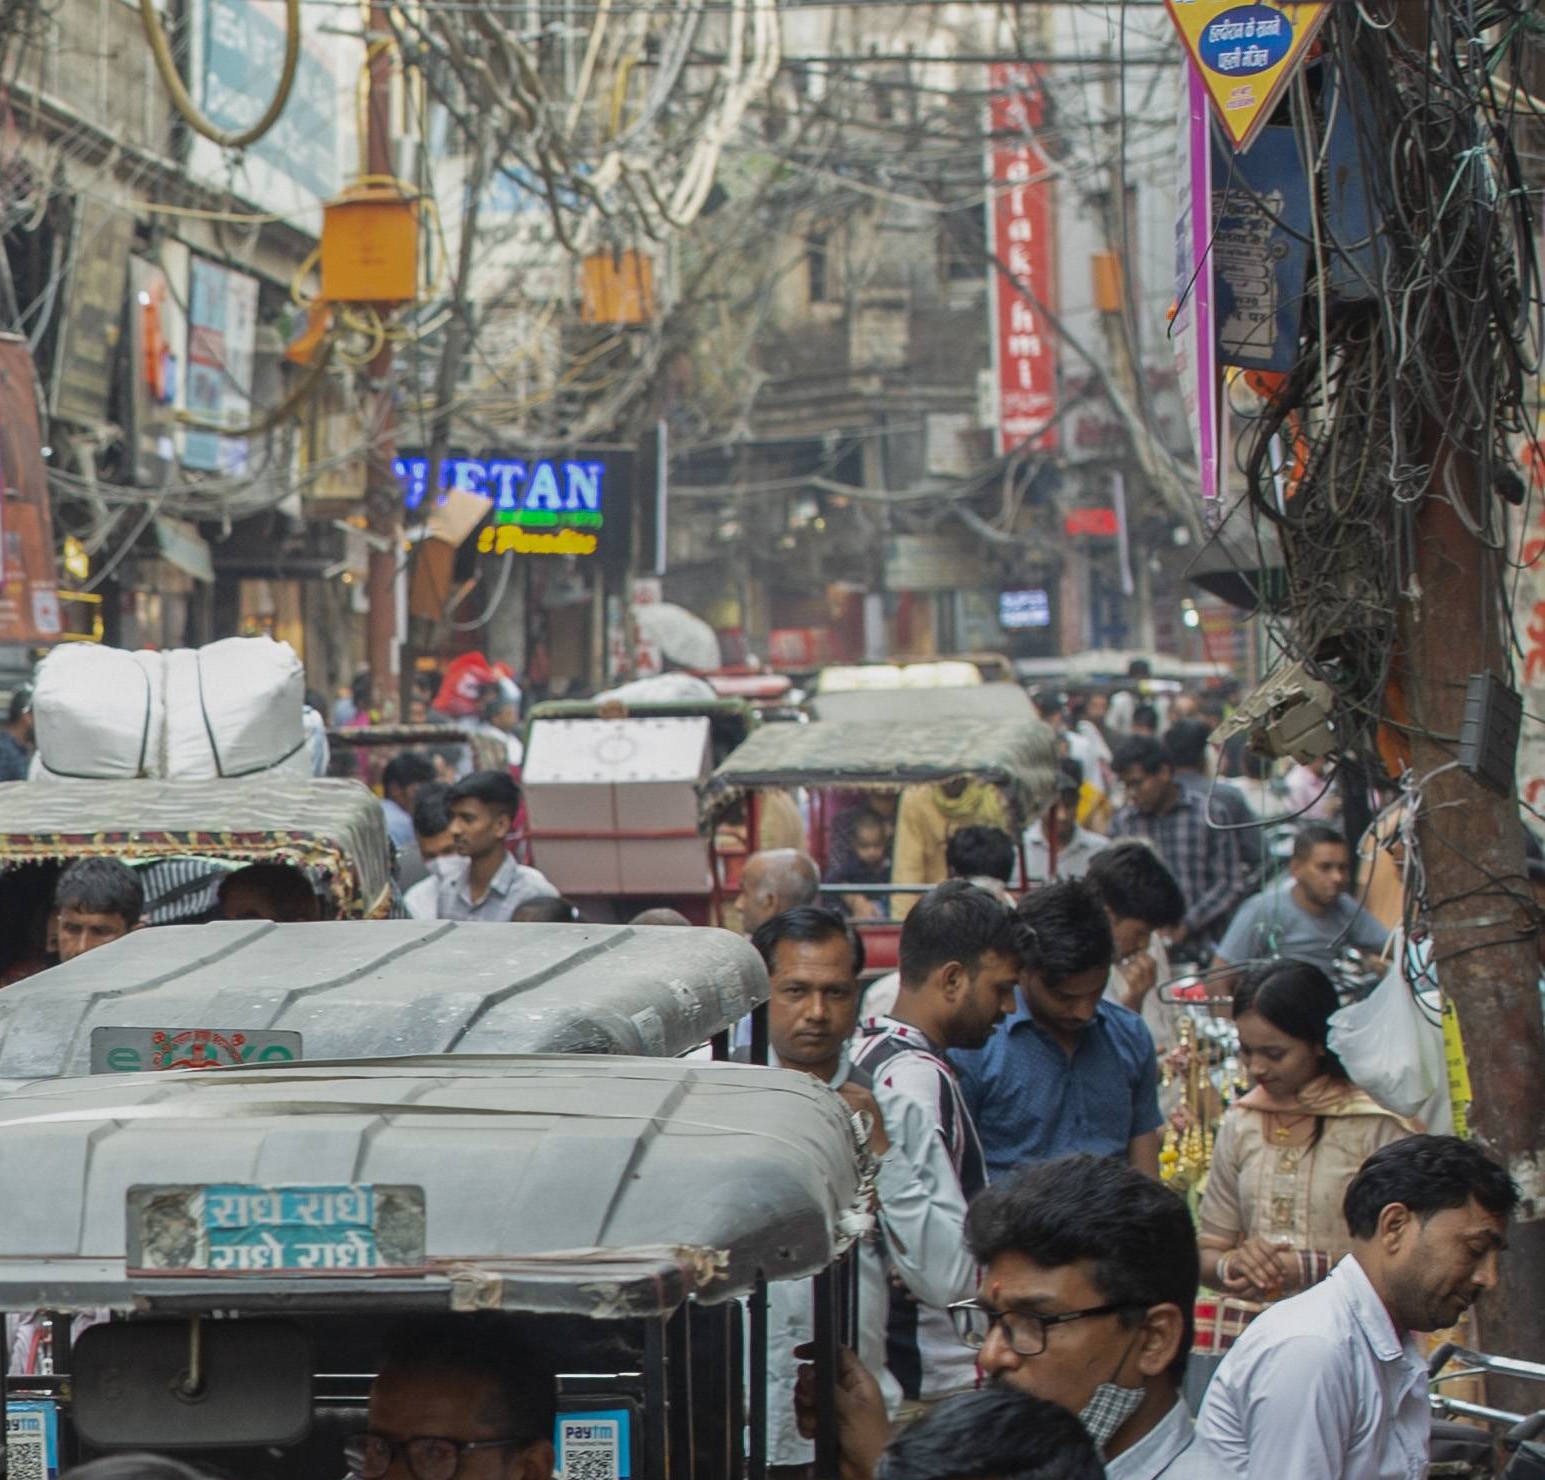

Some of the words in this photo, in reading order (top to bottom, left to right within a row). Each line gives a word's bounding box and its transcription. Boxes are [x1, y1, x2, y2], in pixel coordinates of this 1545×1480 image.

[210, 1188, 283, 1227] राधे
[294, 1185, 370, 1226] राधे
[210, 1231, 286, 1268] राधे
[293, 1230, 372, 1268] राधे
